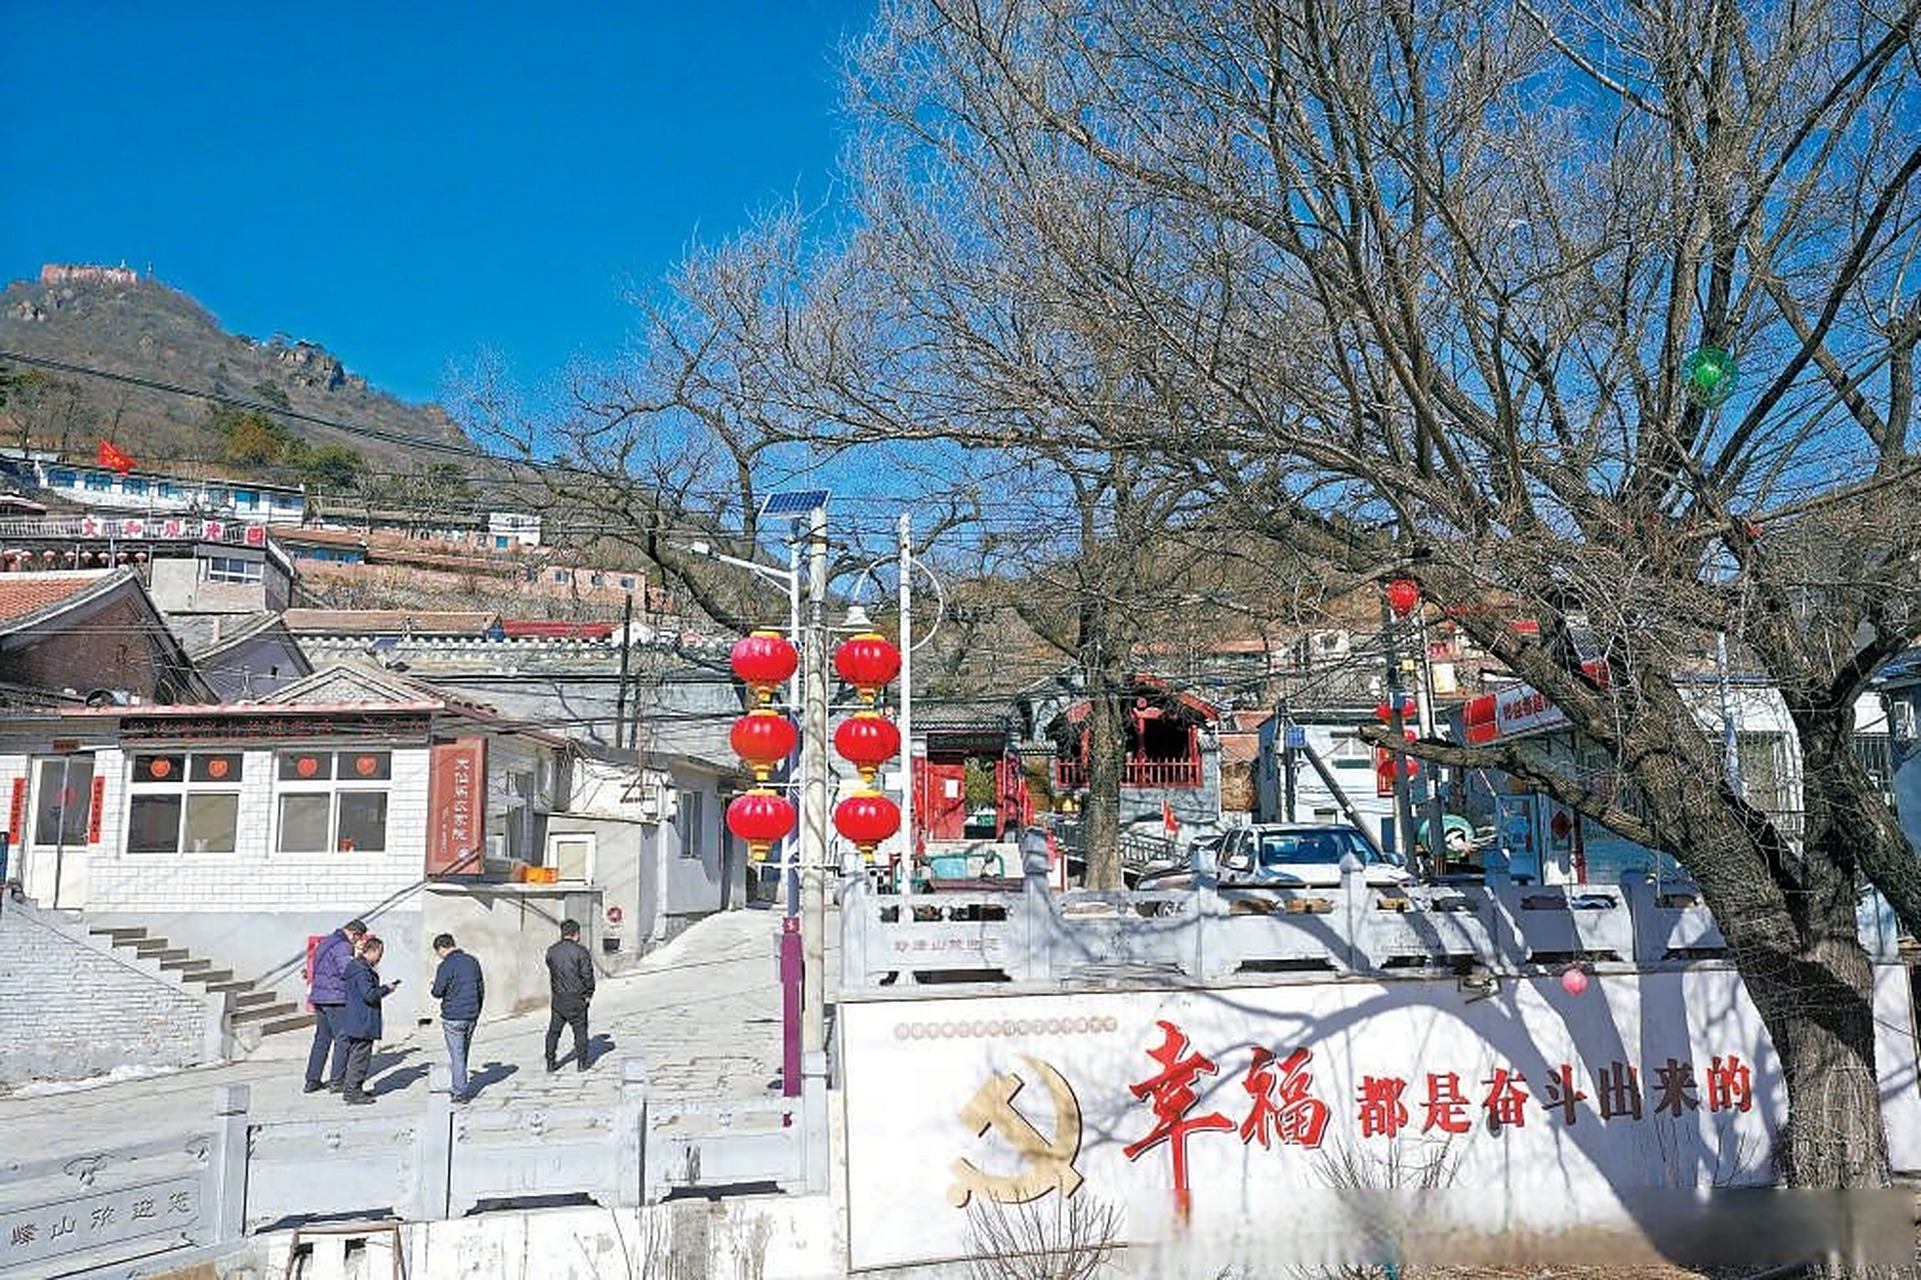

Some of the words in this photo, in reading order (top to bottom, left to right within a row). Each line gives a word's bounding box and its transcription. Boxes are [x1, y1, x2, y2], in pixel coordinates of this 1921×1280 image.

[1123, 1019, 1753, 1222] 幸福都是奋斗出来的
